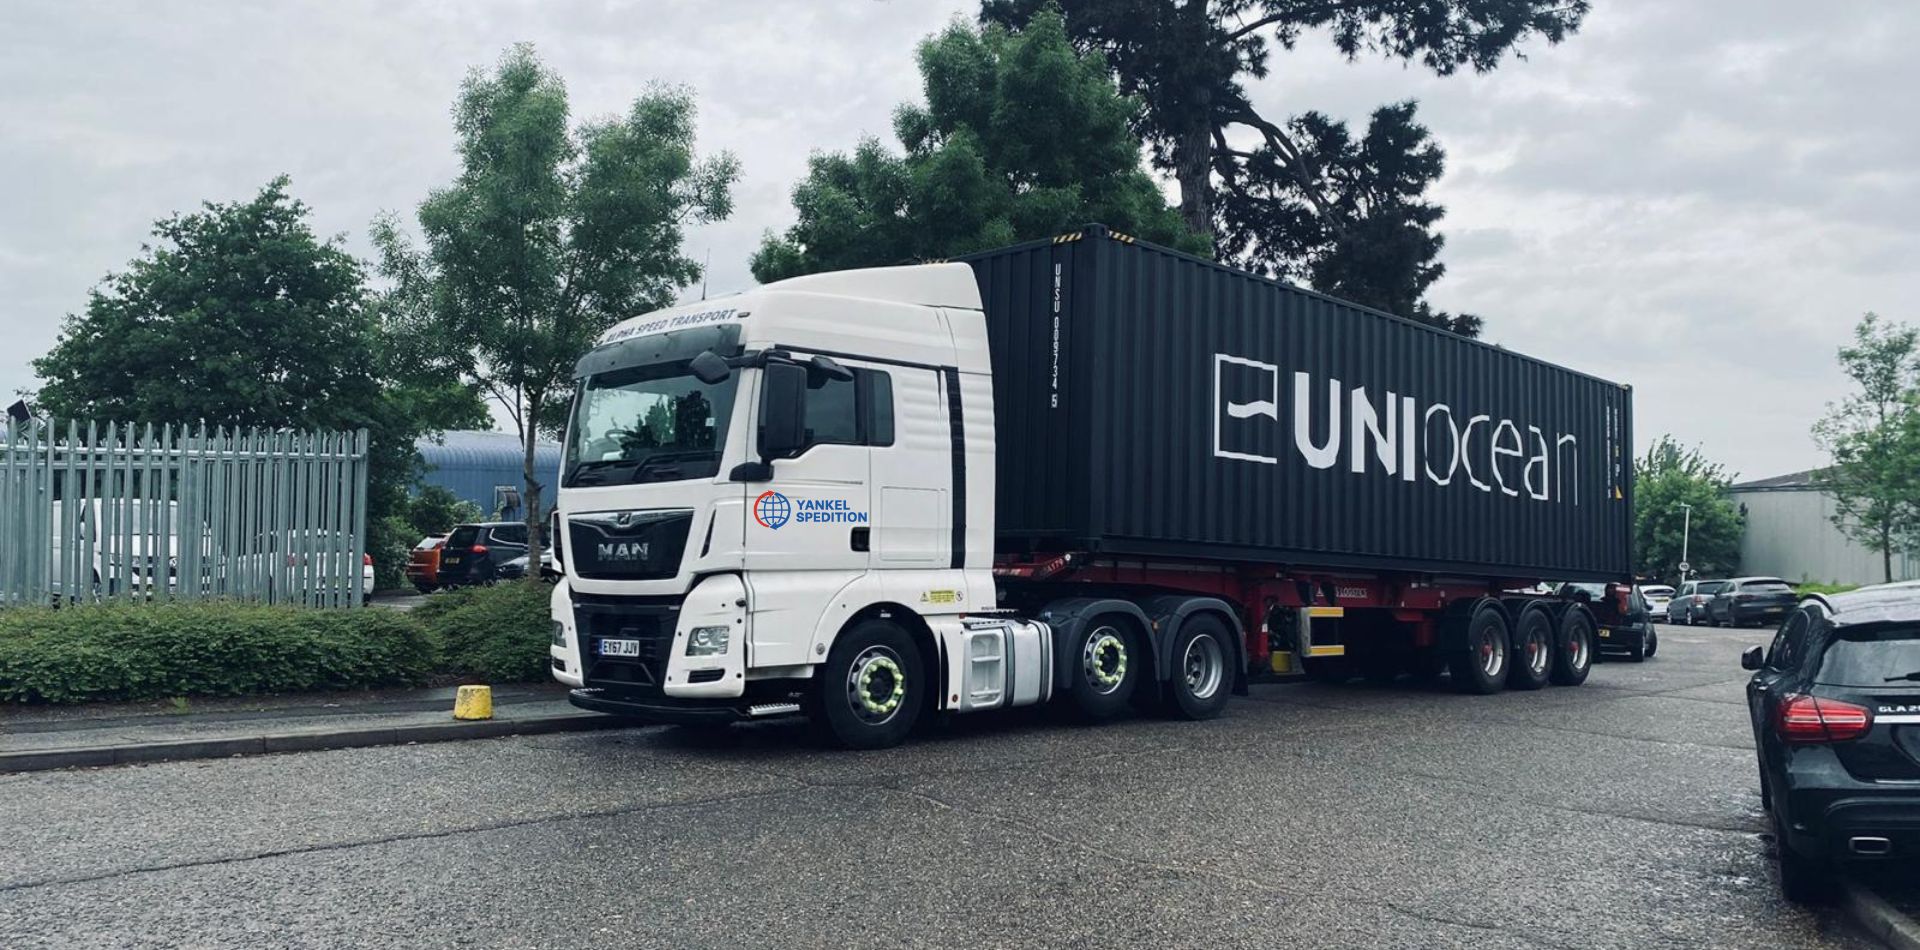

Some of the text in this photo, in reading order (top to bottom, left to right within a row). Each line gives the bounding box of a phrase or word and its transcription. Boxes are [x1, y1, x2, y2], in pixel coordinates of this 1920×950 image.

[637, 319, 668, 334] SPEED
[670, 309, 737, 327] TRANSPORT
[796, 499, 850, 511] YANKEL
[796, 511, 868, 523] SPEDITION
[597, 543, 649, 560] MAN
[603, 641, 621, 654] EY67
[1878, 705, 1907, 713] GLA
